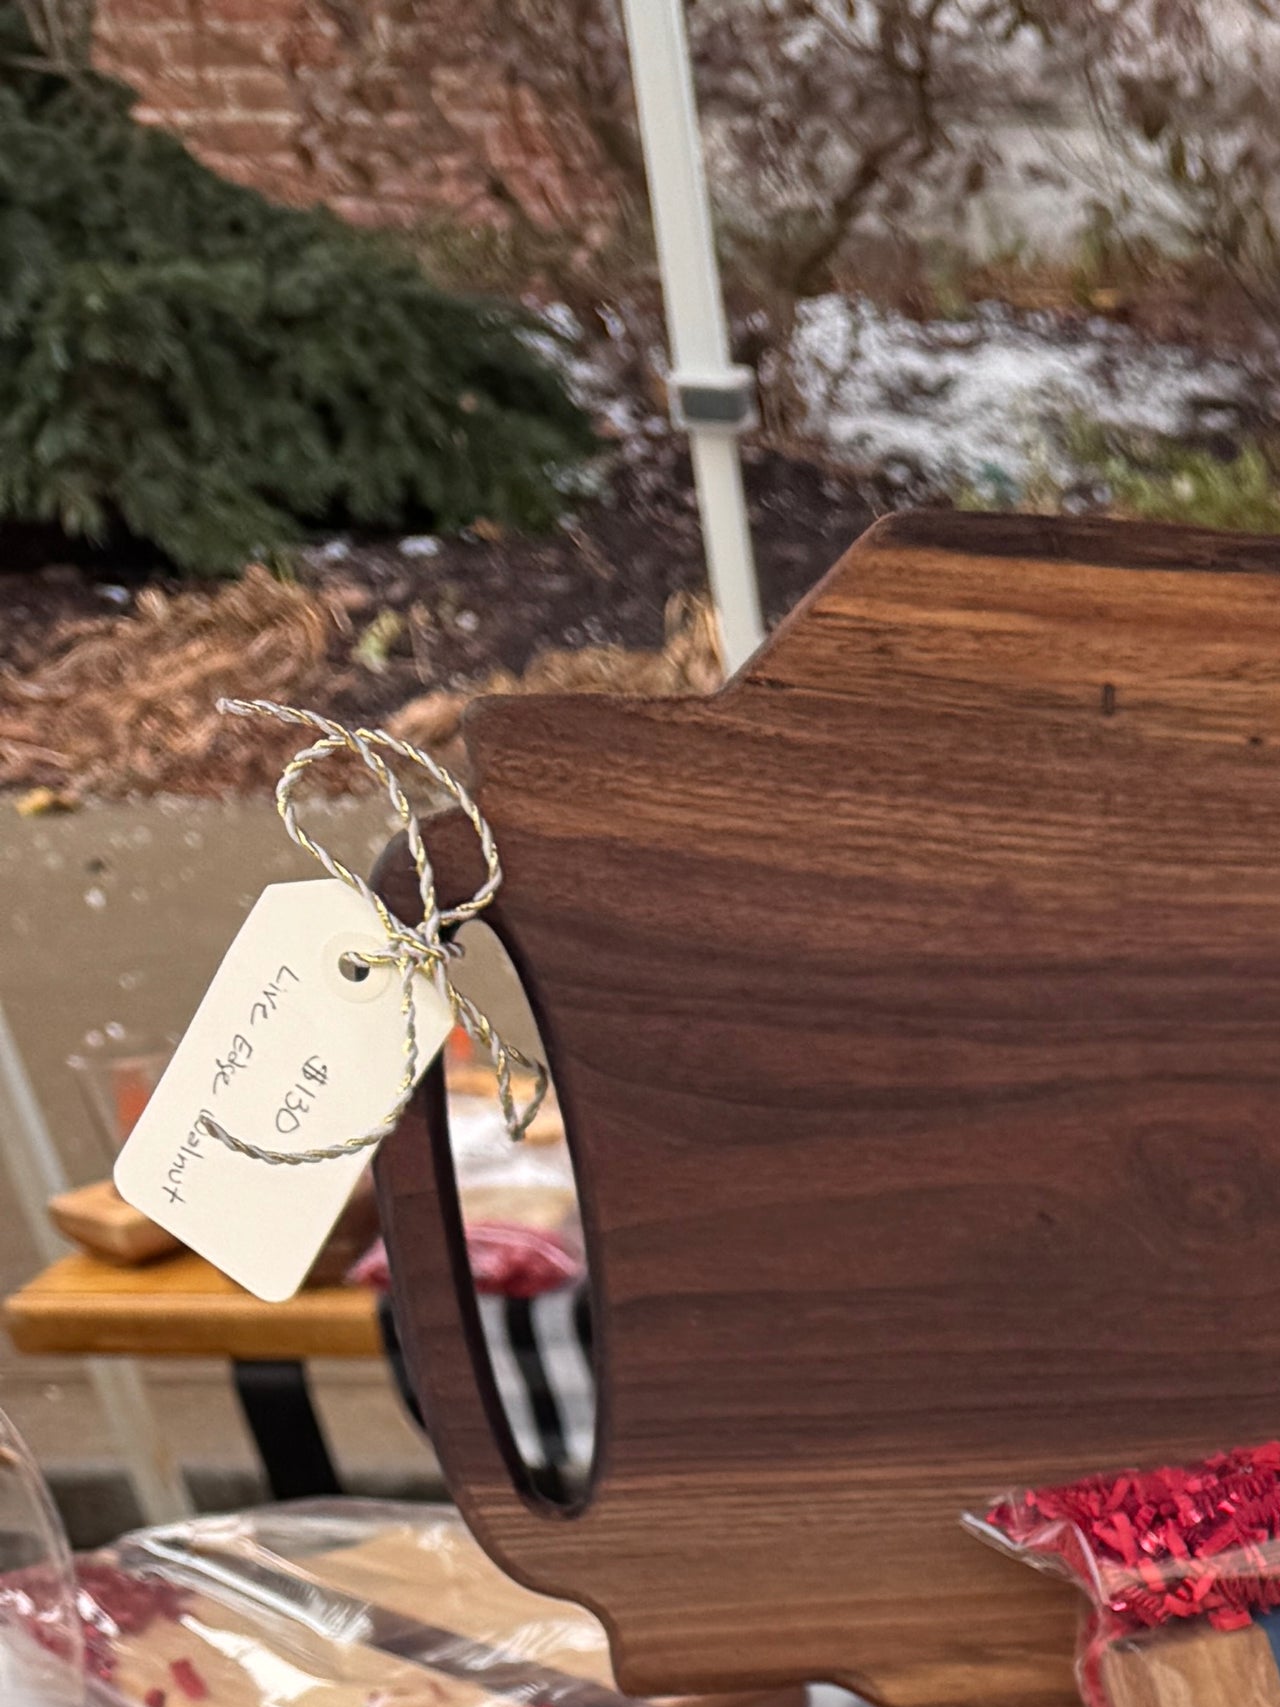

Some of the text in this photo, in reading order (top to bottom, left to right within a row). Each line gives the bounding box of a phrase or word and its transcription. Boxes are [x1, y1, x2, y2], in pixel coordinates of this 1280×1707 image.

[250, 965, 300, 1026] Live
[212, 1034, 254, 1095] Edge
[275, 1055, 329, 1133] $130
